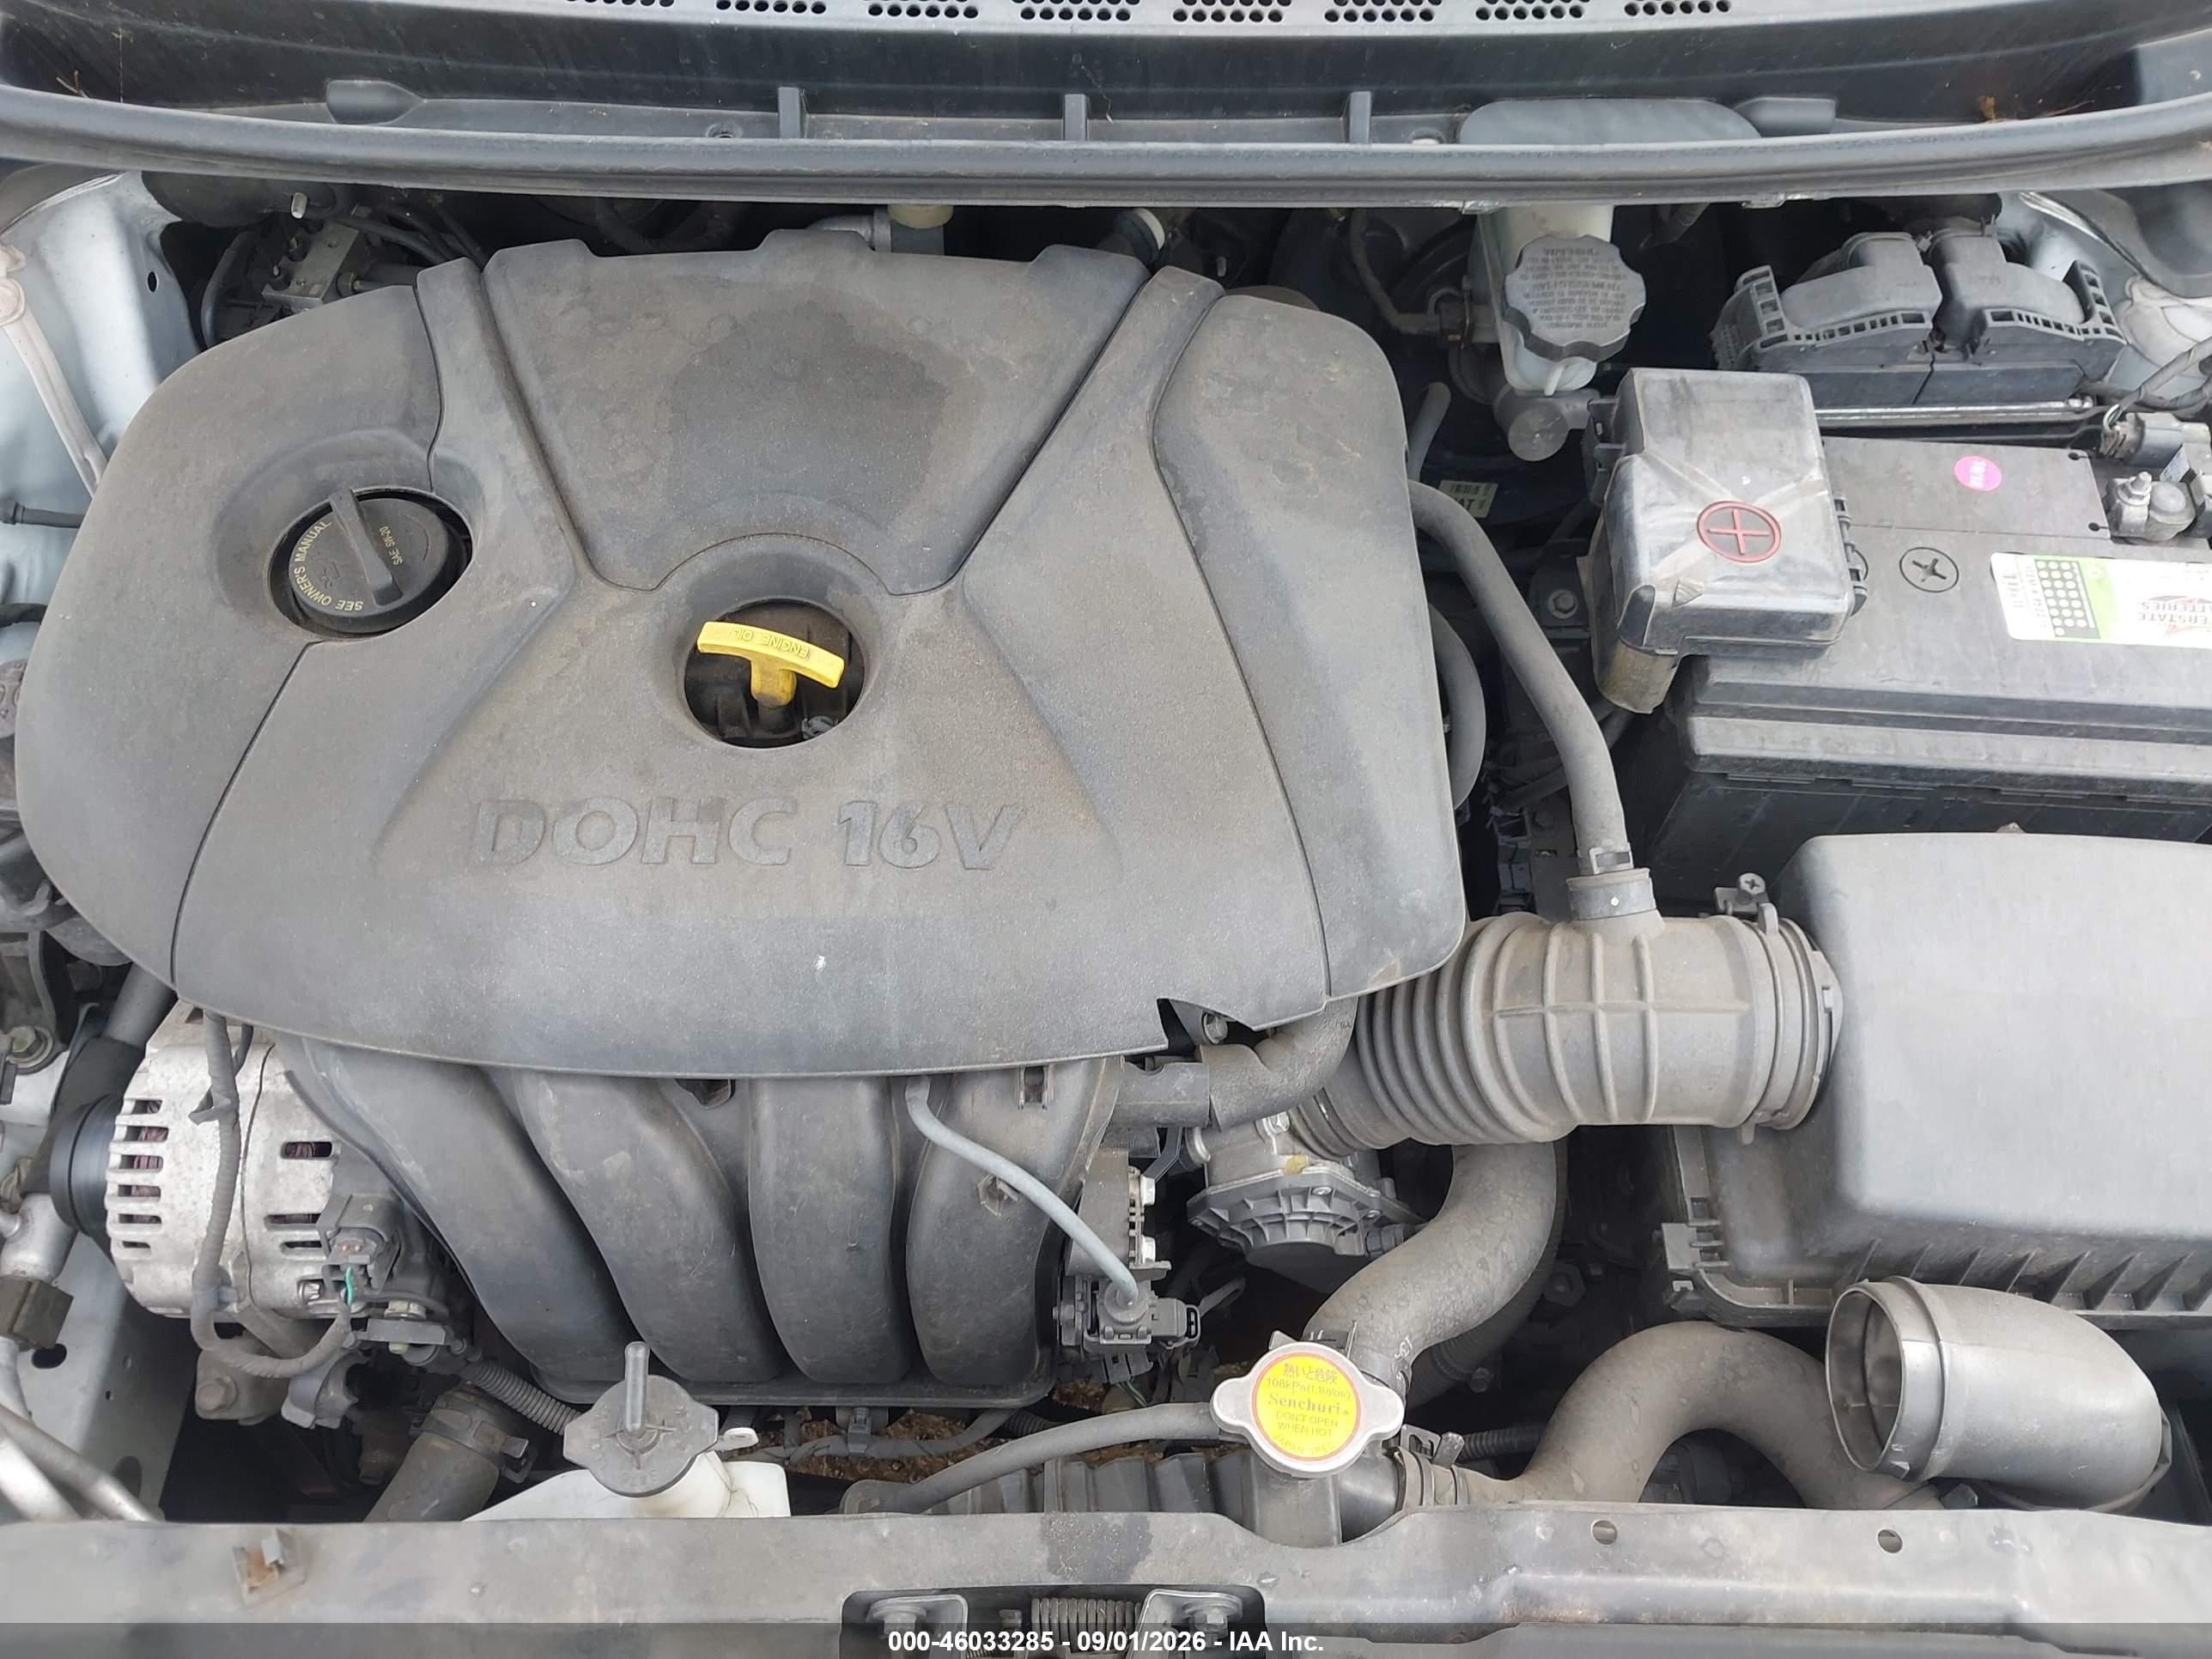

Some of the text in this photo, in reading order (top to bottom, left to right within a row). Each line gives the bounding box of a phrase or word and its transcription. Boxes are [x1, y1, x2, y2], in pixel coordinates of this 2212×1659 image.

[294, 520, 364, 612] SEE OWNER'S MANUAL
[388, 548, 403, 565] SAE
[732, 628, 811, 659] ENGINE OIL
[473, 796, 1019, 871] DOHC 16V
[1268, 1392, 1340, 1415] Senchuri
[1277, 1421, 1333, 1437] WHEN HOT
[1310, 1414, 1339, 1428] OPEN
